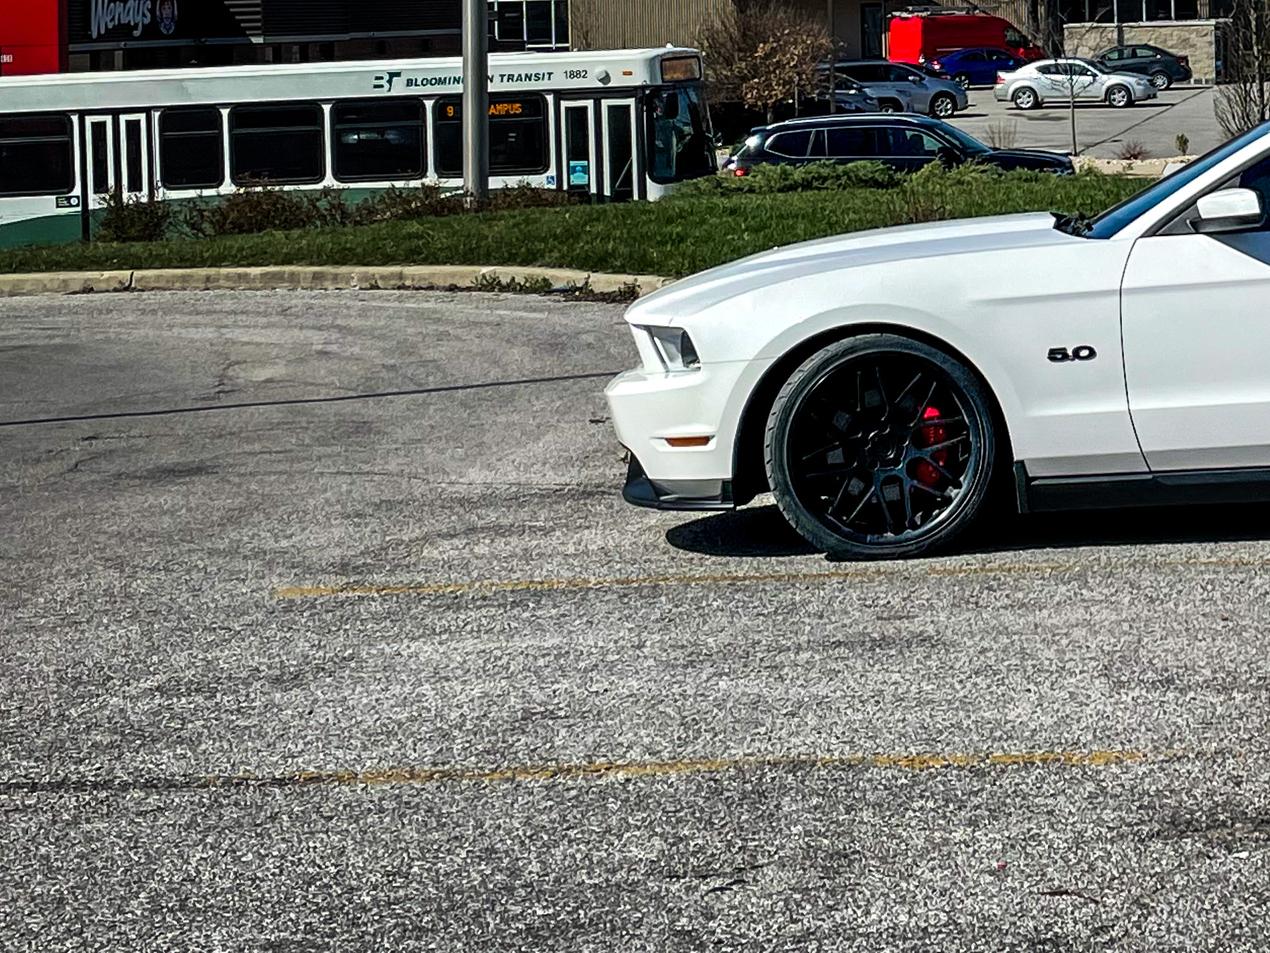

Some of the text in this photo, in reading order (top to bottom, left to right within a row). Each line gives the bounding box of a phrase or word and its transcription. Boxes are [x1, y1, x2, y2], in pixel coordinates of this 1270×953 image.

[405, 72, 554, 87] BLOOMINN TRANSIT
[563, 70, 588, 80] 1882
[446, 103, 522, 117] 9 AMPUS
[1047, 345, 1097, 363] 5.0
